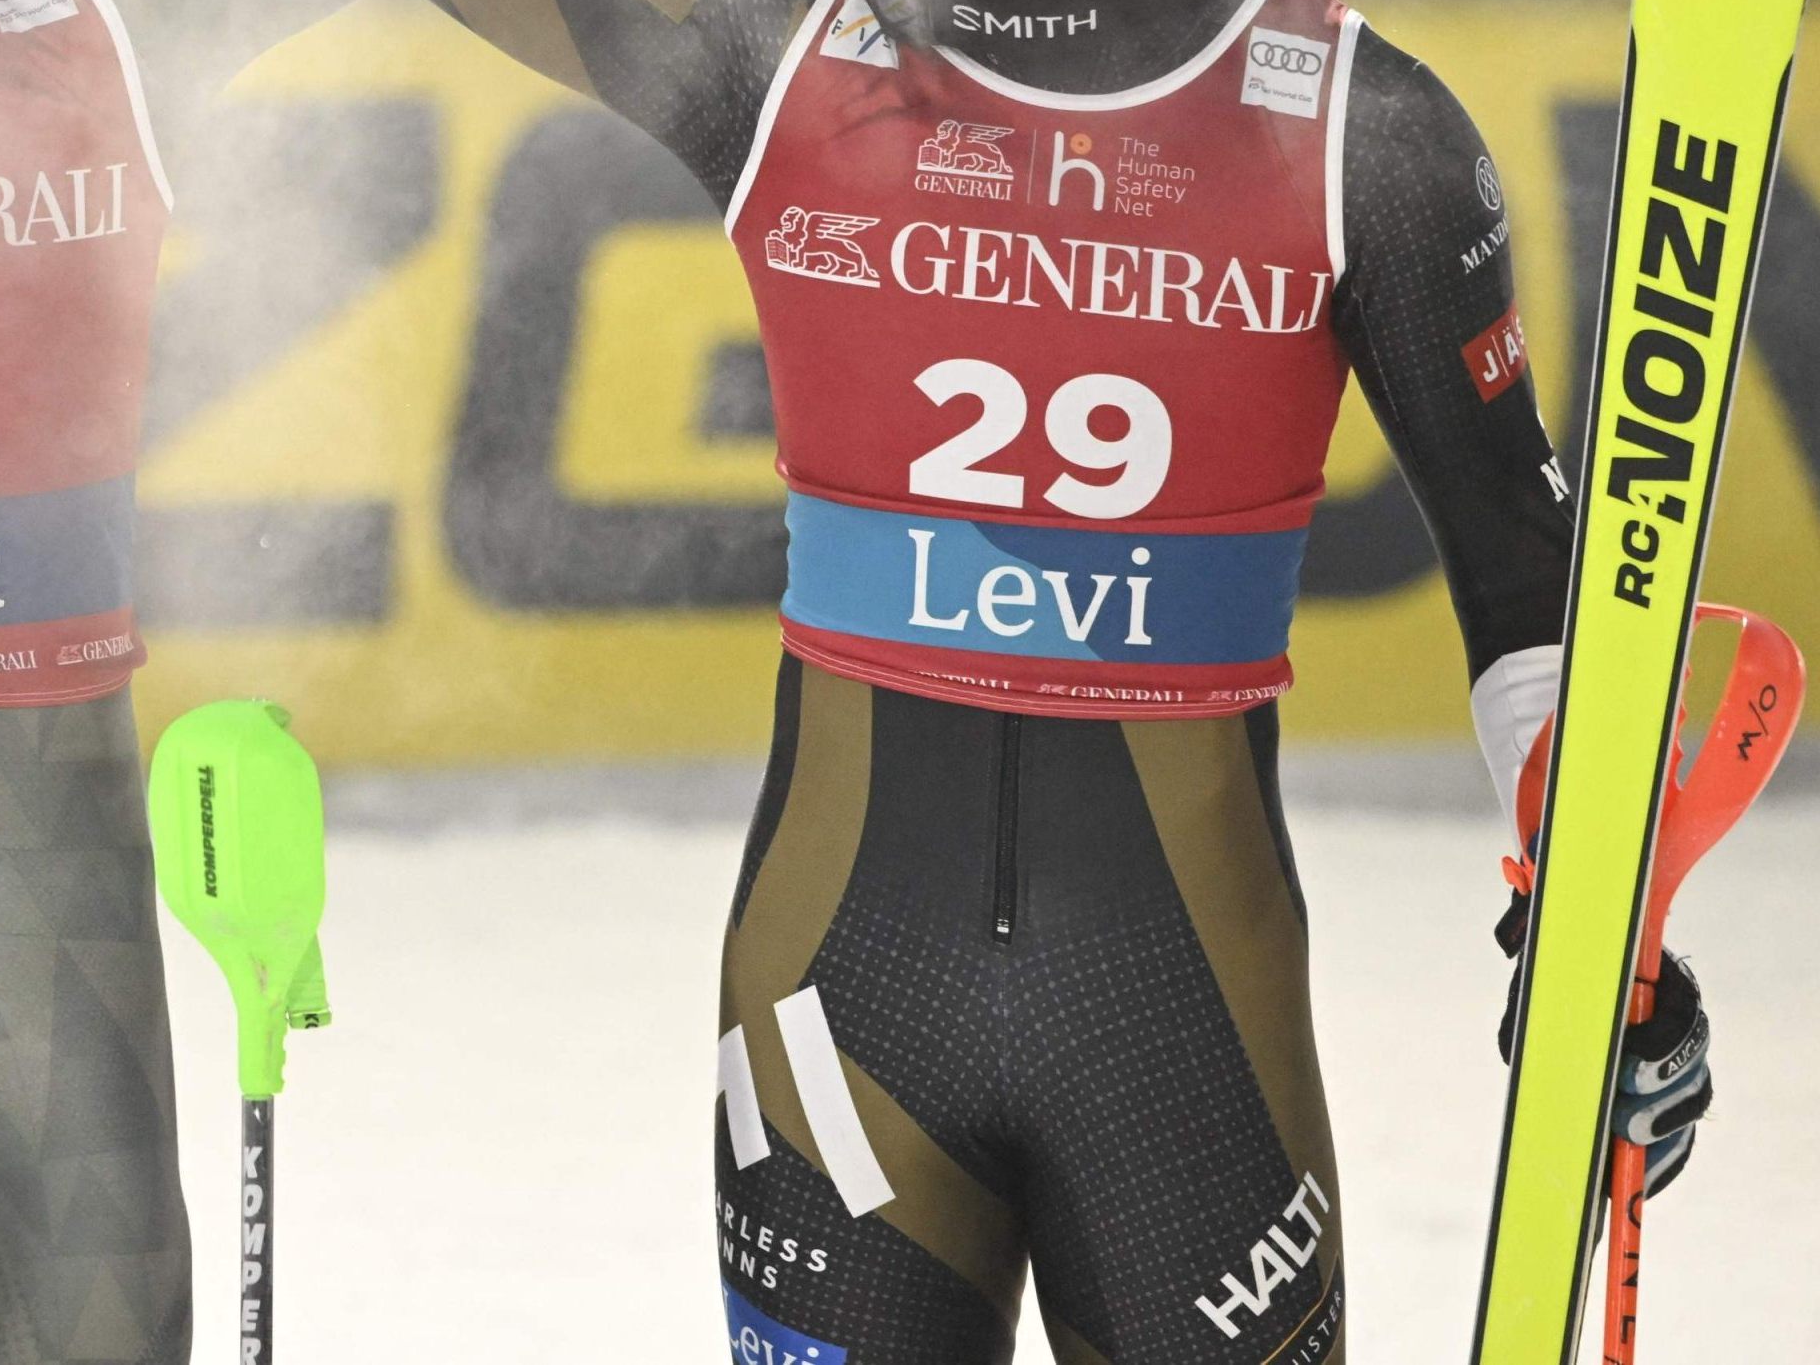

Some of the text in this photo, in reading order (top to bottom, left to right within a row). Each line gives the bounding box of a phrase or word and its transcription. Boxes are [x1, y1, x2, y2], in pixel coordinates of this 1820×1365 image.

[952, 5, 1097, 39] SMITH
[1118, 157, 1196, 181] Human
[1119, 137, 1160, 157] The
[914, 173, 1012, 201] GENERALI
[1114, 197, 1154, 217] Net
[1115, 176, 1186, 203] Safety
[889, 221, 1331, 334] GENERALI
[1607, 121, 1738, 524] NOIZE
[908, 358, 1173, 520] 29
[907, 529, 1153, 647] Levi
[198, 764, 218, 899] KOMPERDELL
[1194, 1170, 1330, 1340] HALTI
